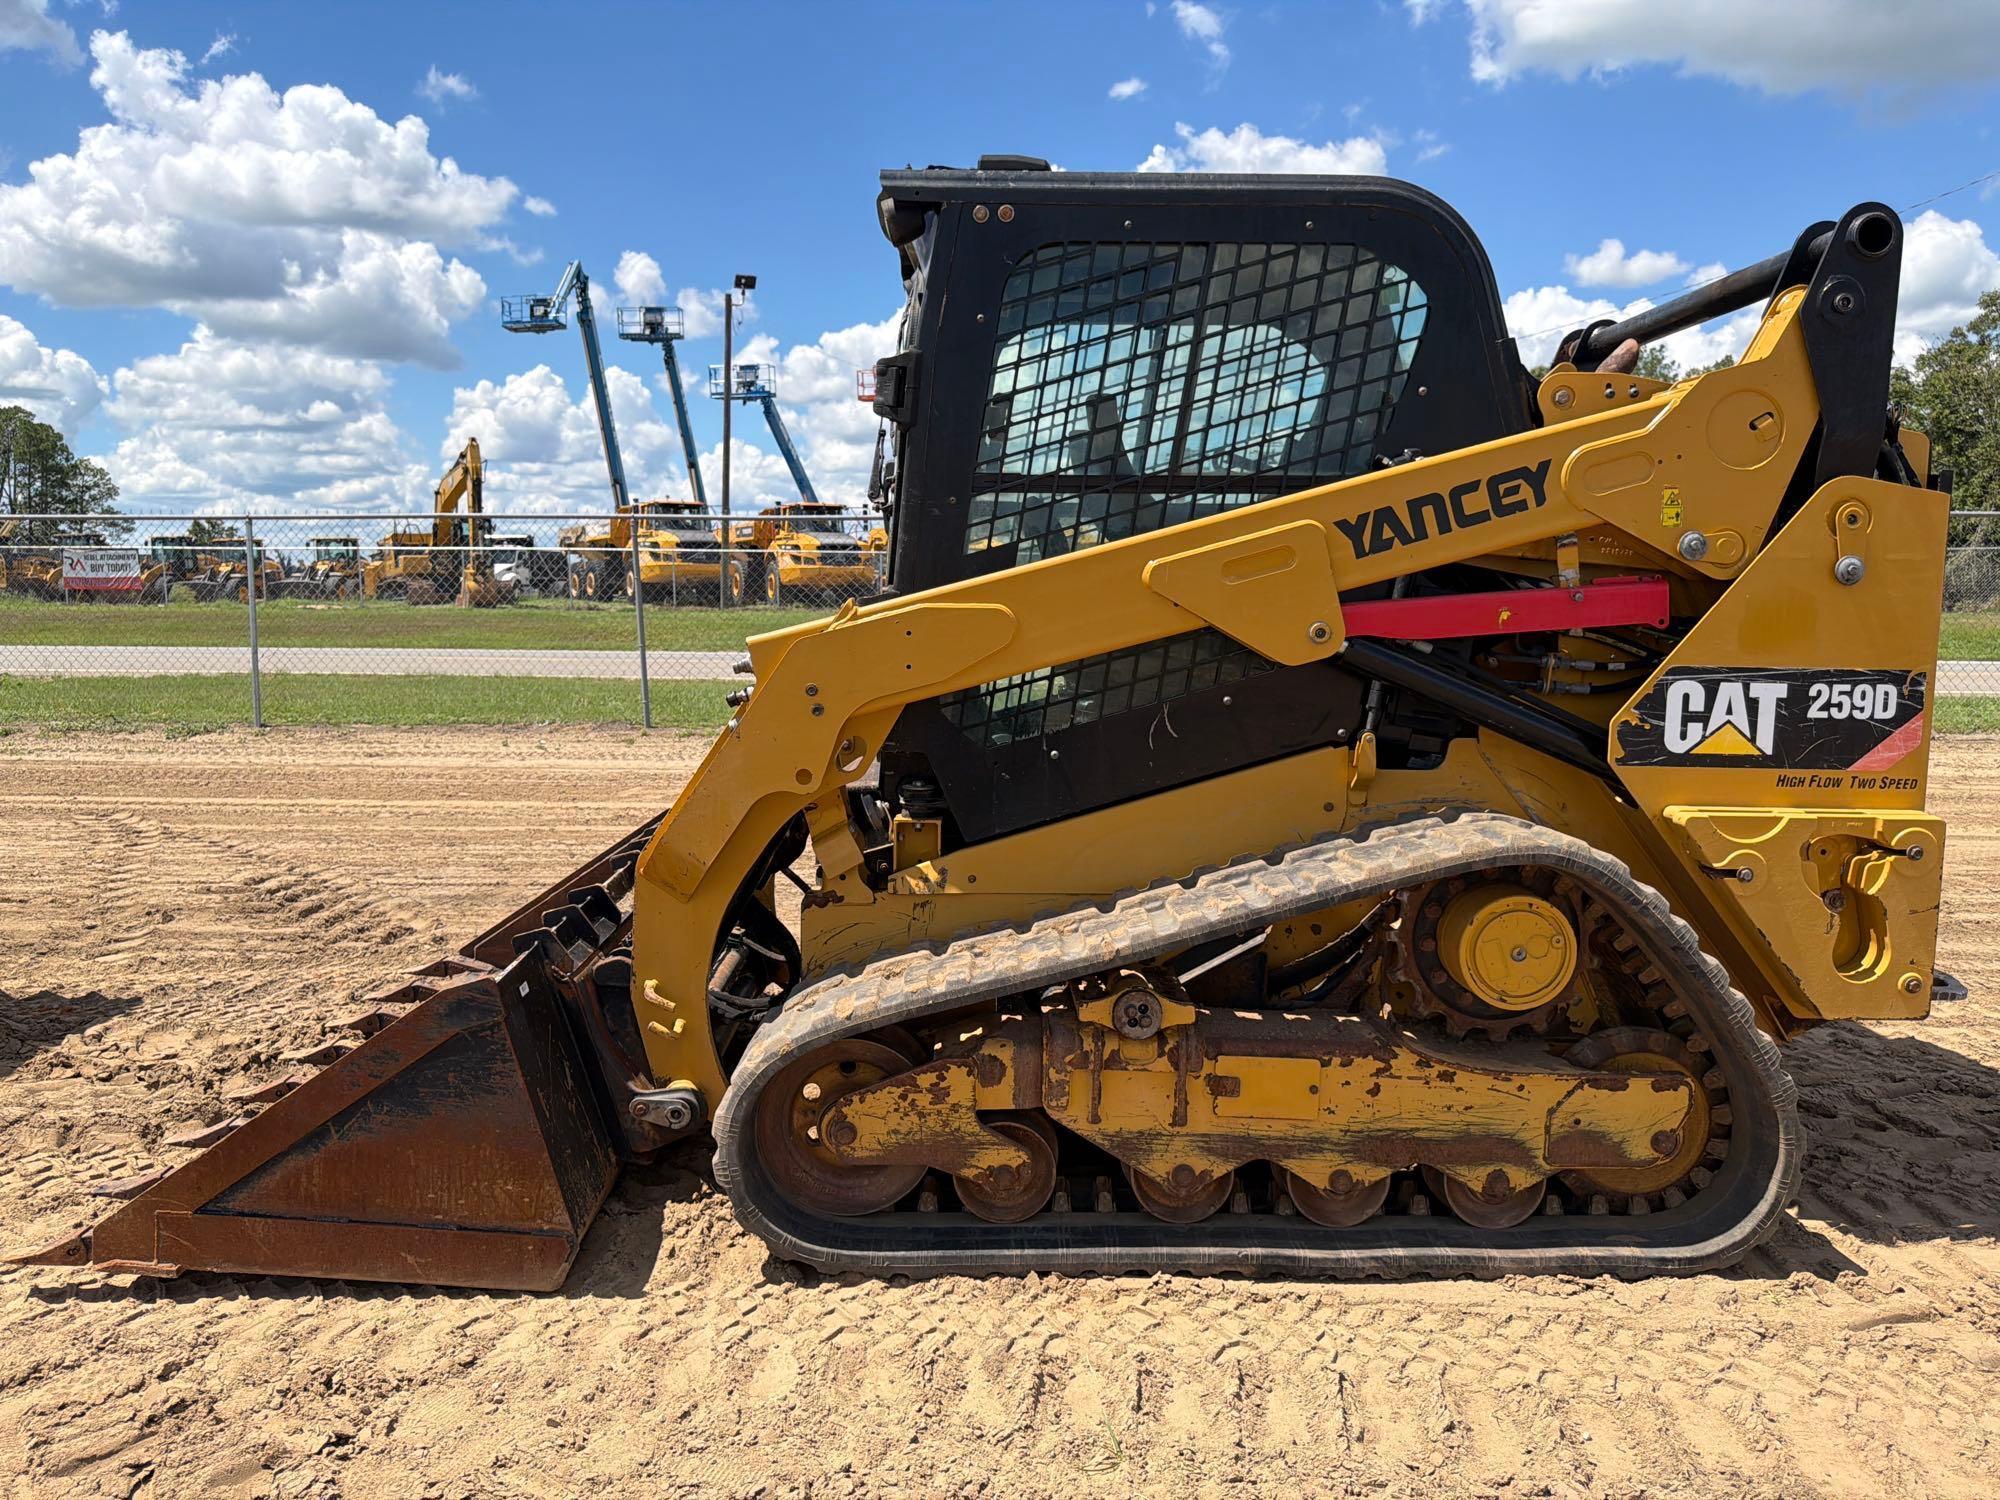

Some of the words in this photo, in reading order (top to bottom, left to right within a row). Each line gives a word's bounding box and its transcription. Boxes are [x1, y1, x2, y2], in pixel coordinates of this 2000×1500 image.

[1333, 459, 1552, 560] YANCEY
[90, 563, 105, 573] BUY
[1663, 680, 1788, 756] CAT
[1806, 683, 1898, 720] 259D
[1775, 774, 1806, 789] HIGH
[1809, 775, 1843, 790] FLOW
[1850, 775, 1876, 790] TWO
[1878, 776, 1919, 791] SPEED
